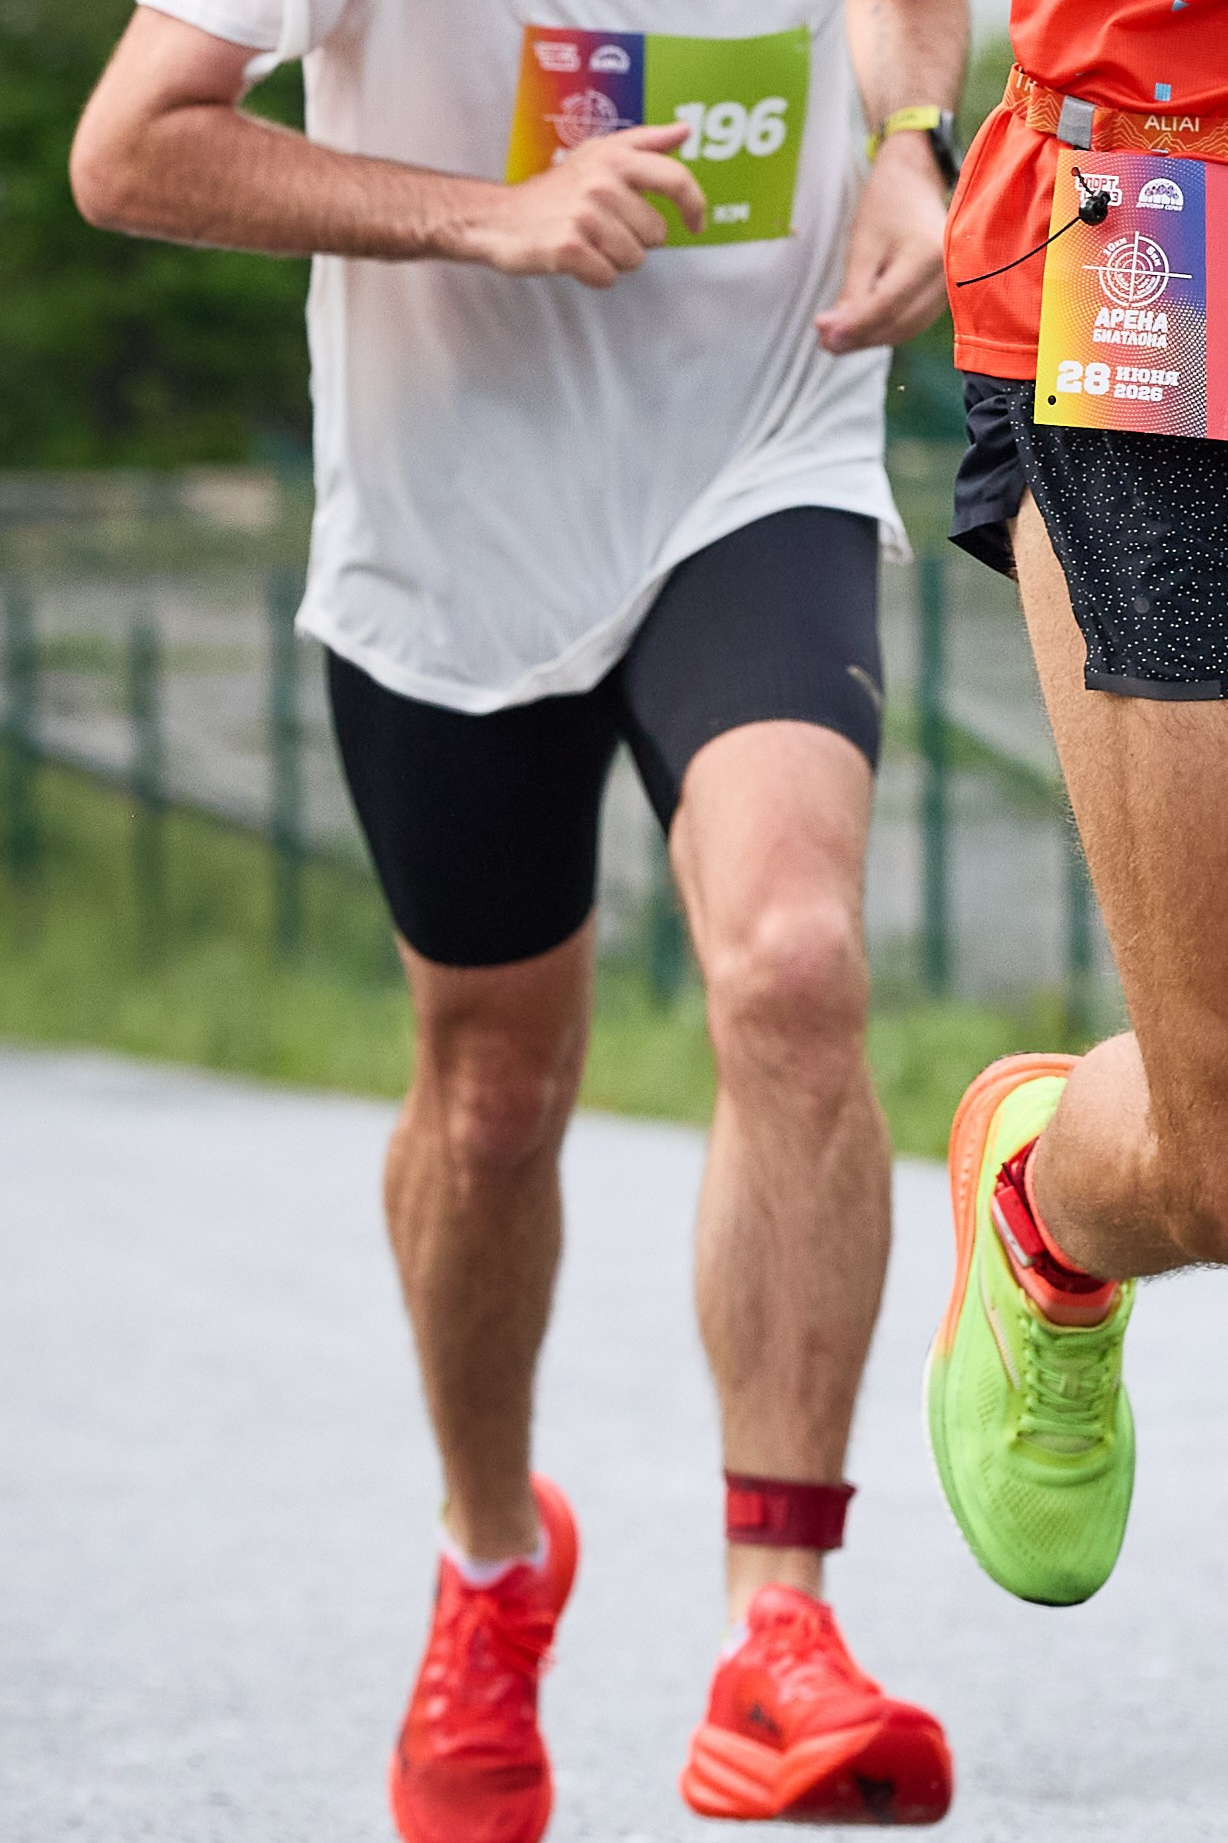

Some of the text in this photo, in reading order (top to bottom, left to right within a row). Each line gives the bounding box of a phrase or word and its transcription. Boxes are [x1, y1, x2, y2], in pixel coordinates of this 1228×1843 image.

[674, 96, 788, 161] 196
[1095, 307, 1168, 332] АРЕНА
[1093, 329, 1167, 348] БИАТЛОНА
[1056, 360, 1111, 395] 28
